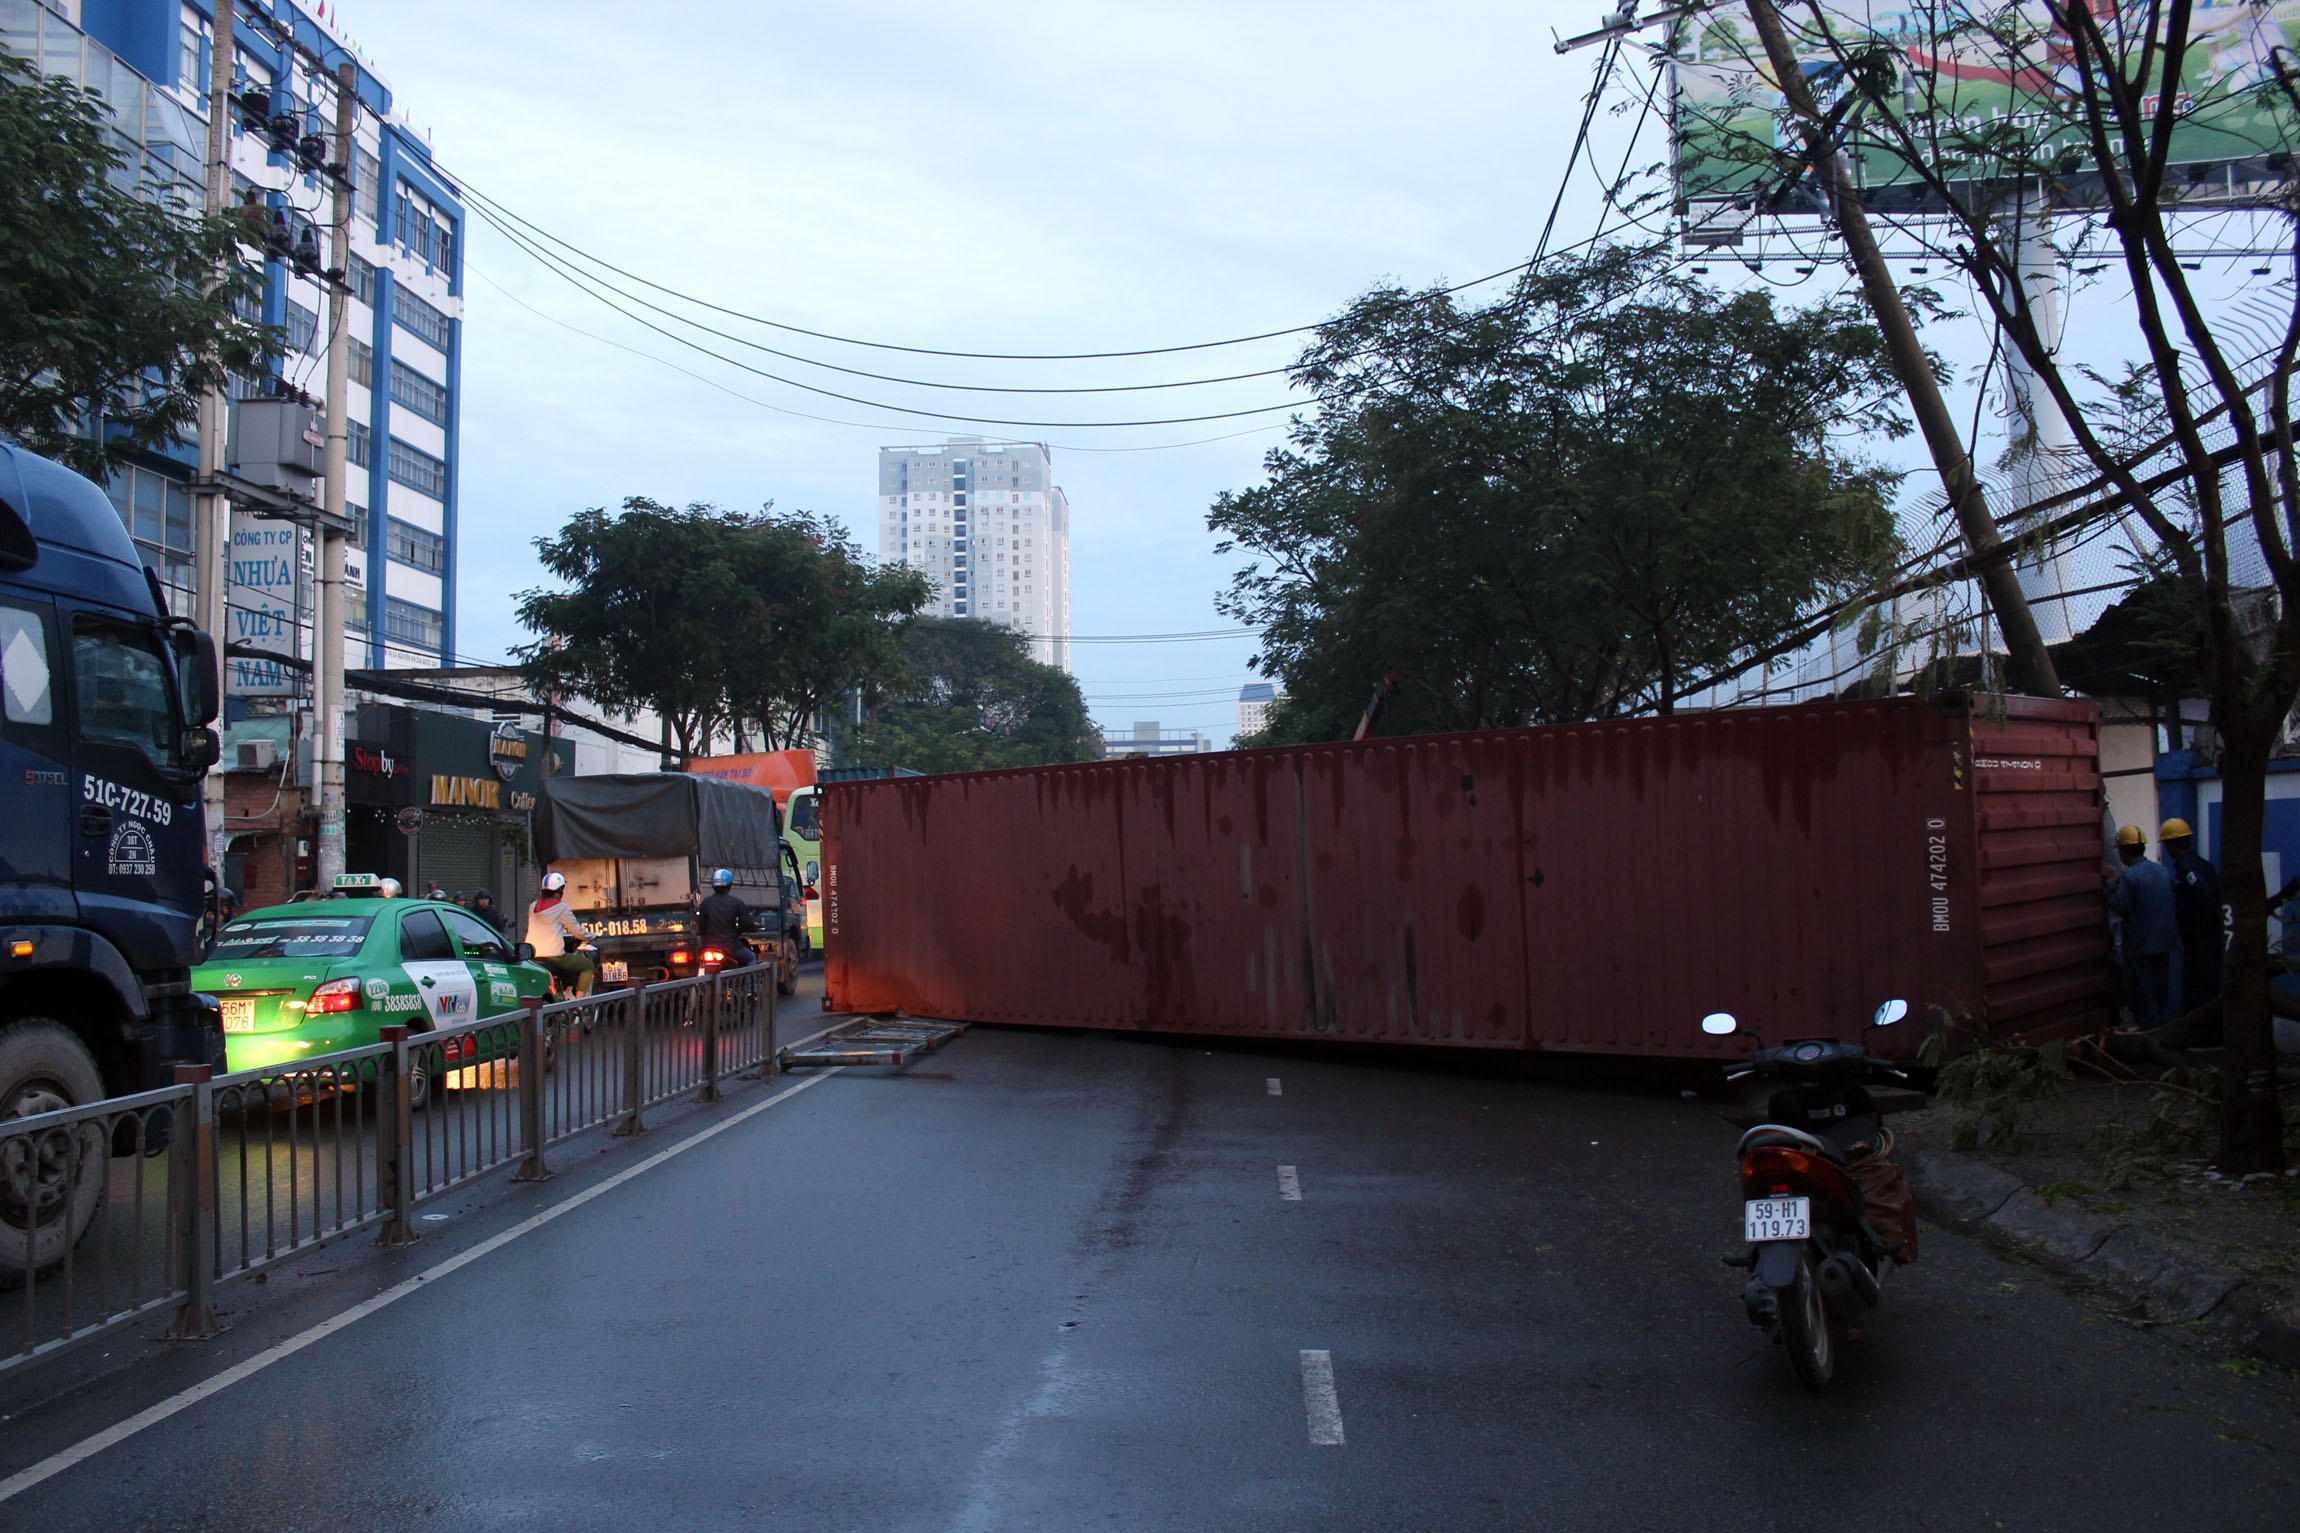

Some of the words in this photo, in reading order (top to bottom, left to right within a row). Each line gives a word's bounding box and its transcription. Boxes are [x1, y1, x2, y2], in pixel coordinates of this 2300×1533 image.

[234, 528, 261, 546] CÔNG
[264, 532, 277, 545] TY
[279, 530, 293, 545] CP
[233, 555, 292, 592] NHỰA
[236, 603, 286, 643] VIỆT
[236, 660, 283, 687] NAM
[84, 774, 172, 826] 51C-727.59
[430, 774, 500, 810] MANOR
[510, 790, 537, 811] Coffee
[1929, 835, 1948, 892] 474202
[1932, 897, 1950, 932] BMOU
[582, 919, 647, 937] 51C-018.58
[222, 1001, 246, 1016] 56M
[385, 994, 422, 1013] 38383838
[225, 1016, 249, 1030] 076
[1755, 1201, 1797, 1220] 59-H1
[1750, 1219, 1806, 1238] 119.73
